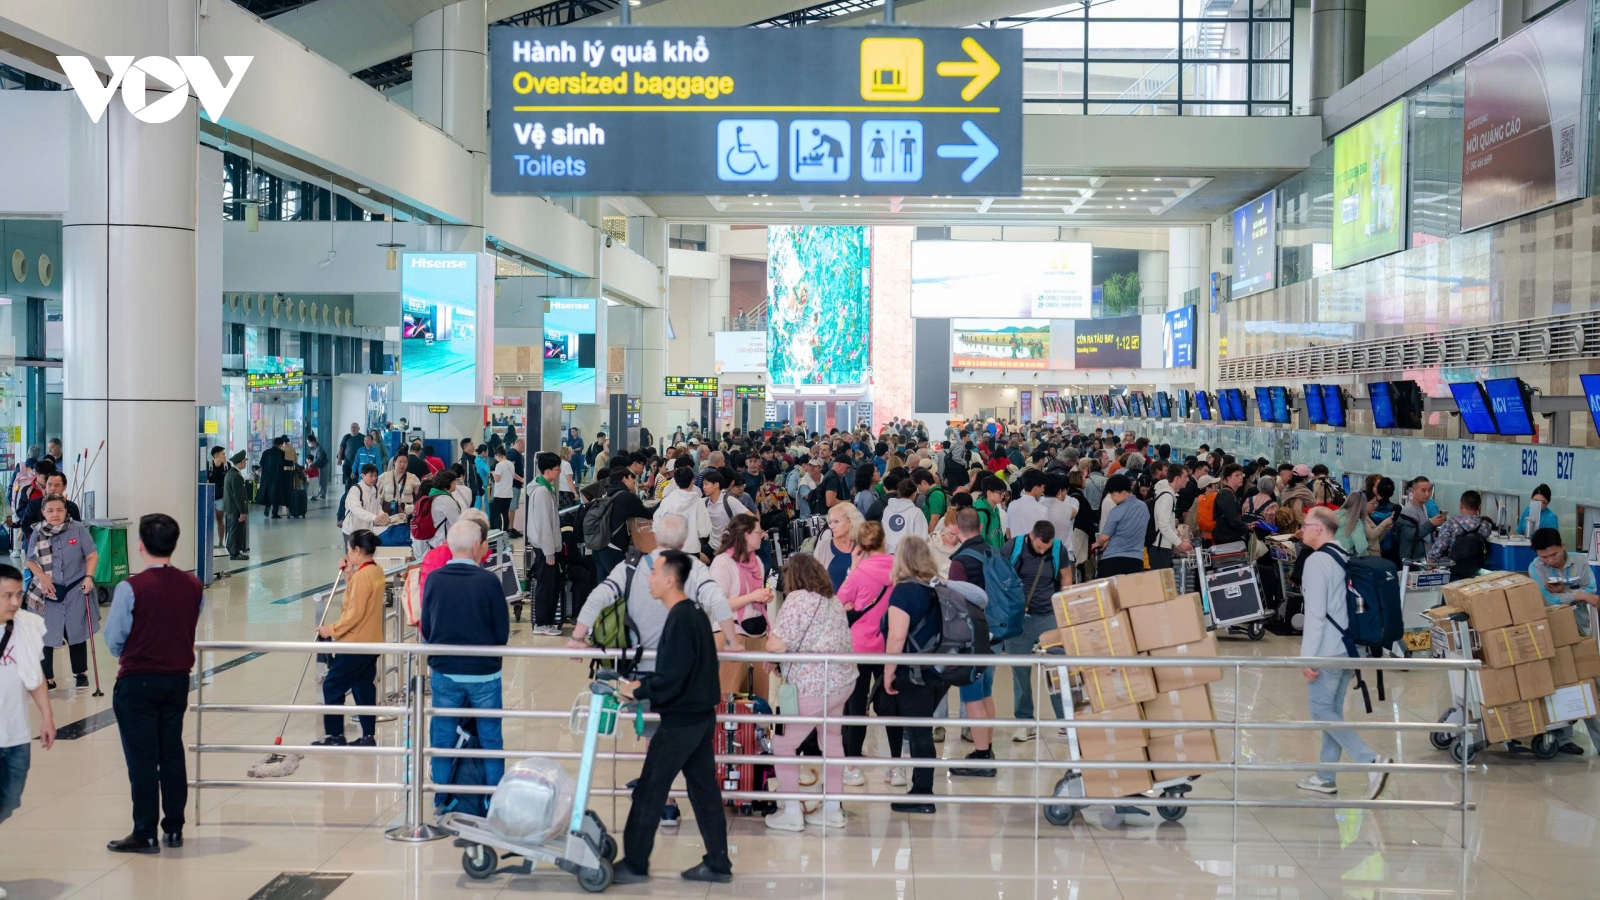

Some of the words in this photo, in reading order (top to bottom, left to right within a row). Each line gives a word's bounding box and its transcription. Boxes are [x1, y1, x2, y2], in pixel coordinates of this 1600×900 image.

[512, 40, 577, 63] Hành
[583, 39, 606, 68] lý
[610, 39, 657, 68] quá
[663, 34, 710, 63] khổ
[512, 70, 628, 95] Oversized
[633, 70, 735, 100] baggage
[513, 122, 546, 150] Vệ
[551, 122, 605, 145] sinh
[1480, 123, 1504, 151] QUẢNG
[1504, 114, 1521, 137] CÁO
[513, 154, 587, 177] Toilets
[411, 257, 467, 269] Hisense
[550, 302, 589, 310] Hisense
[1087, 334, 1094, 344] RA
[1115, 335, 1130, 350] 1-12
[1492, 396, 1507, 413] ACV
[1371, 439, 1382, 461] B22
[1391, 440, 1402, 463] B23
[1436, 443, 1449, 467] B24
[1461, 444, 1475, 470] B25
[1521, 448, 1538, 477] B26
[1557, 451, 1575, 480] B27
